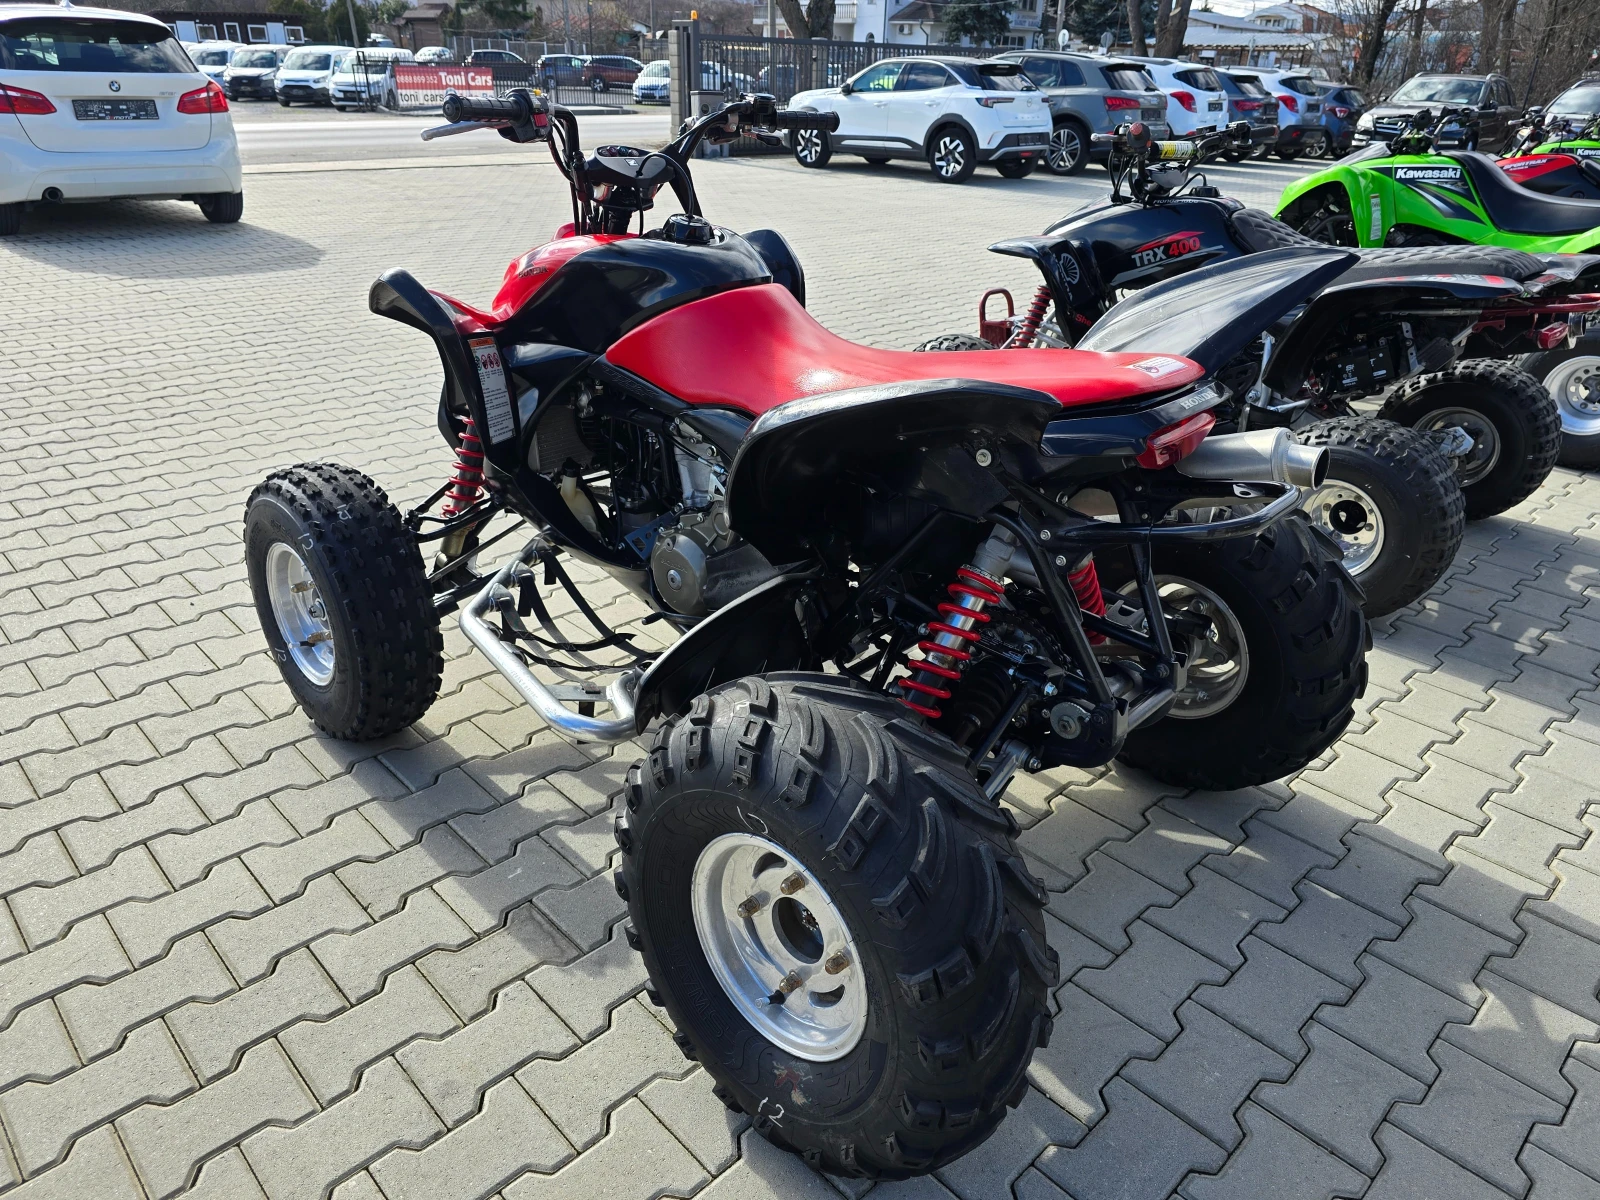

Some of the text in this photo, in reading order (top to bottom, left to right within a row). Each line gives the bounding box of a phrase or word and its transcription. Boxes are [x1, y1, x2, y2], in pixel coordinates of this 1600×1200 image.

[439, 72, 465, 86] Toni
[468, 72, 493, 86] Cars
[1396, 167, 1462, 179] Kawasaki
[1132, 236, 1201, 268] TRX 400
[519, 265, 549, 278] HONDA
[1180, 389, 1218, 410] HONDA
